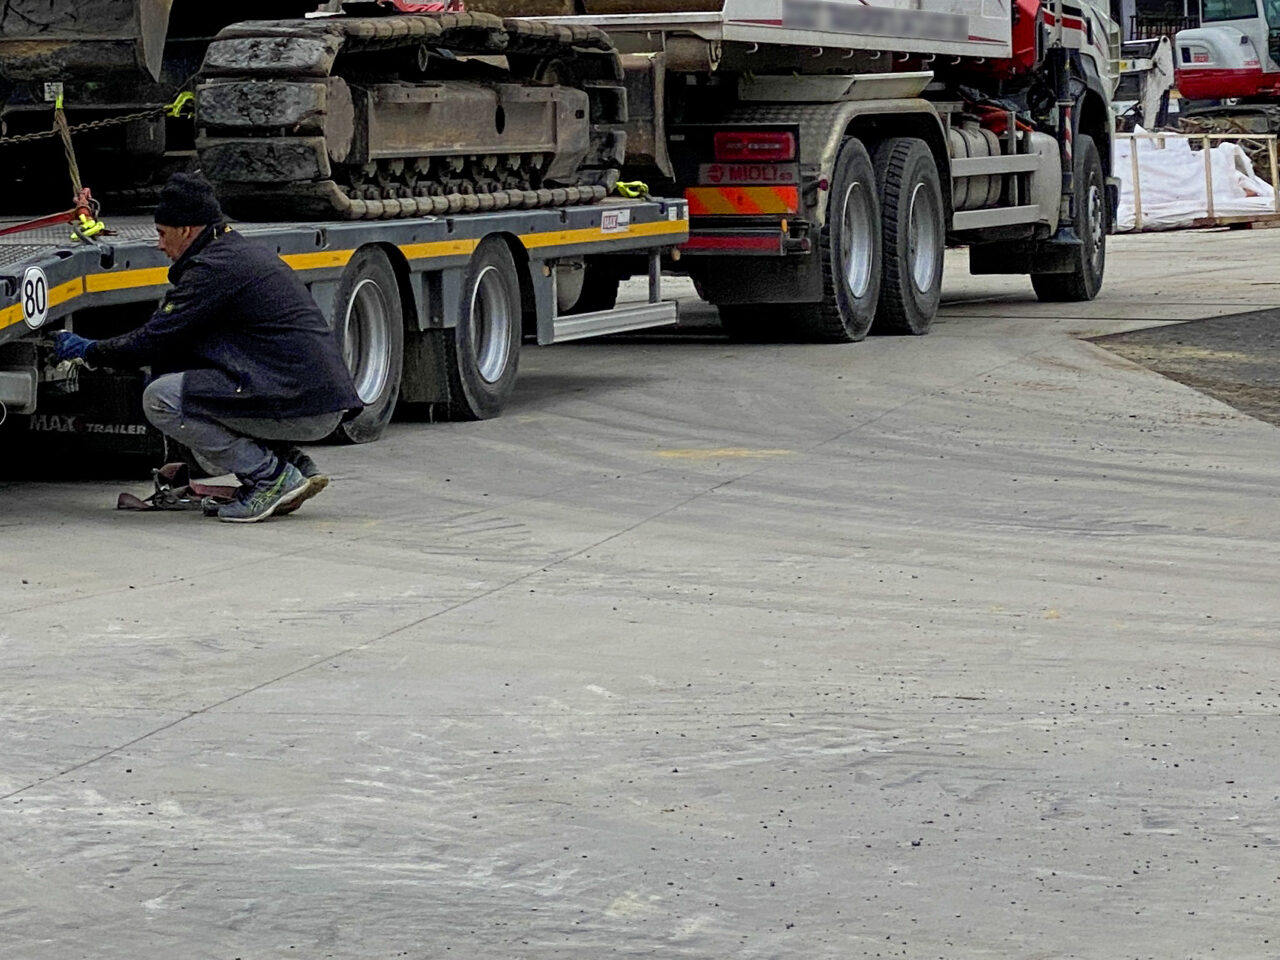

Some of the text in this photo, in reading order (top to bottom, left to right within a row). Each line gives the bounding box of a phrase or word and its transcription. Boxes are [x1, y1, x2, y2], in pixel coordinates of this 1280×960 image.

[24, 277, 46, 319] 80
[30, 414, 147, 435] MAX TRAILER
